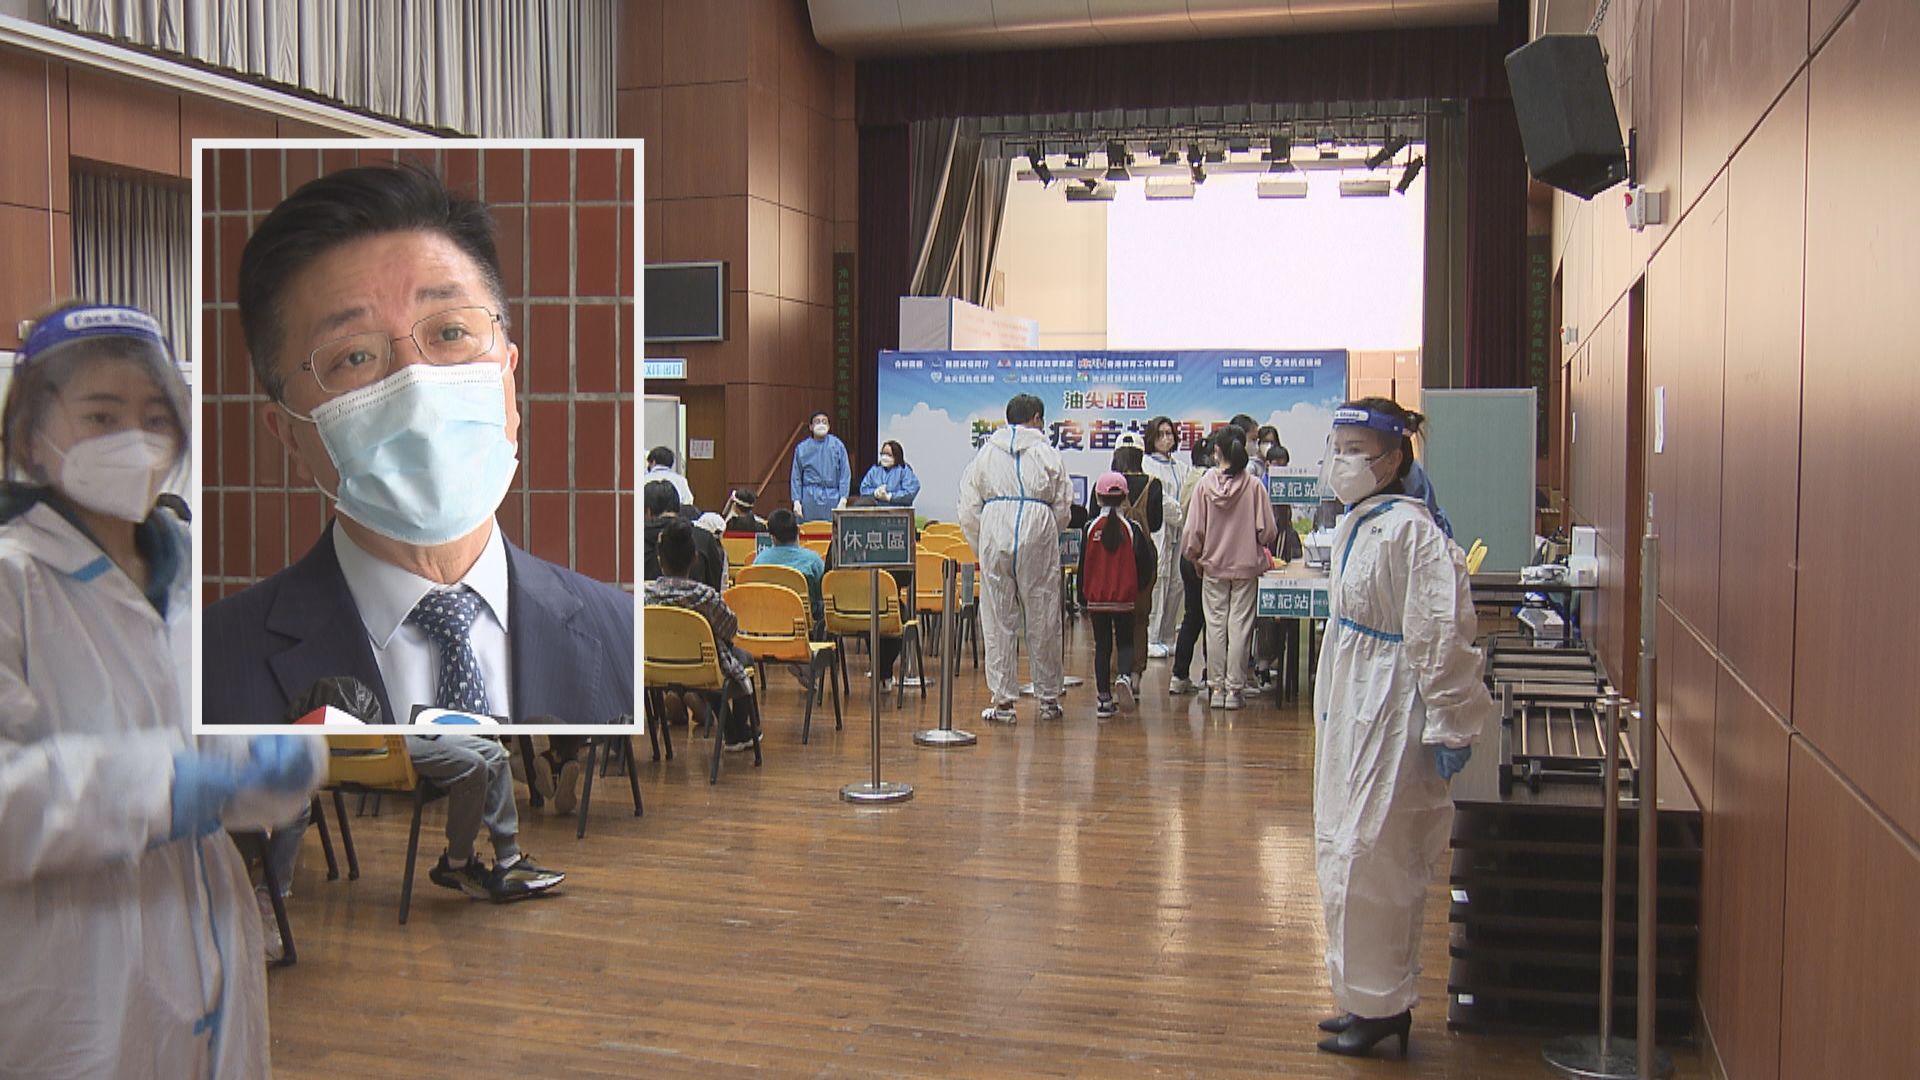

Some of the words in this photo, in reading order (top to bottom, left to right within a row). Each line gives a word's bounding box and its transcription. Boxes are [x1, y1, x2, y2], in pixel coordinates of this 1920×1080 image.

[1063, 390, 1148, 411] 油尖旺區
[1271, 480, 1319, 498] 登記站
[842, 529, 905, 551] 休息區
[1261, 592, 1309, 610] 登記站
